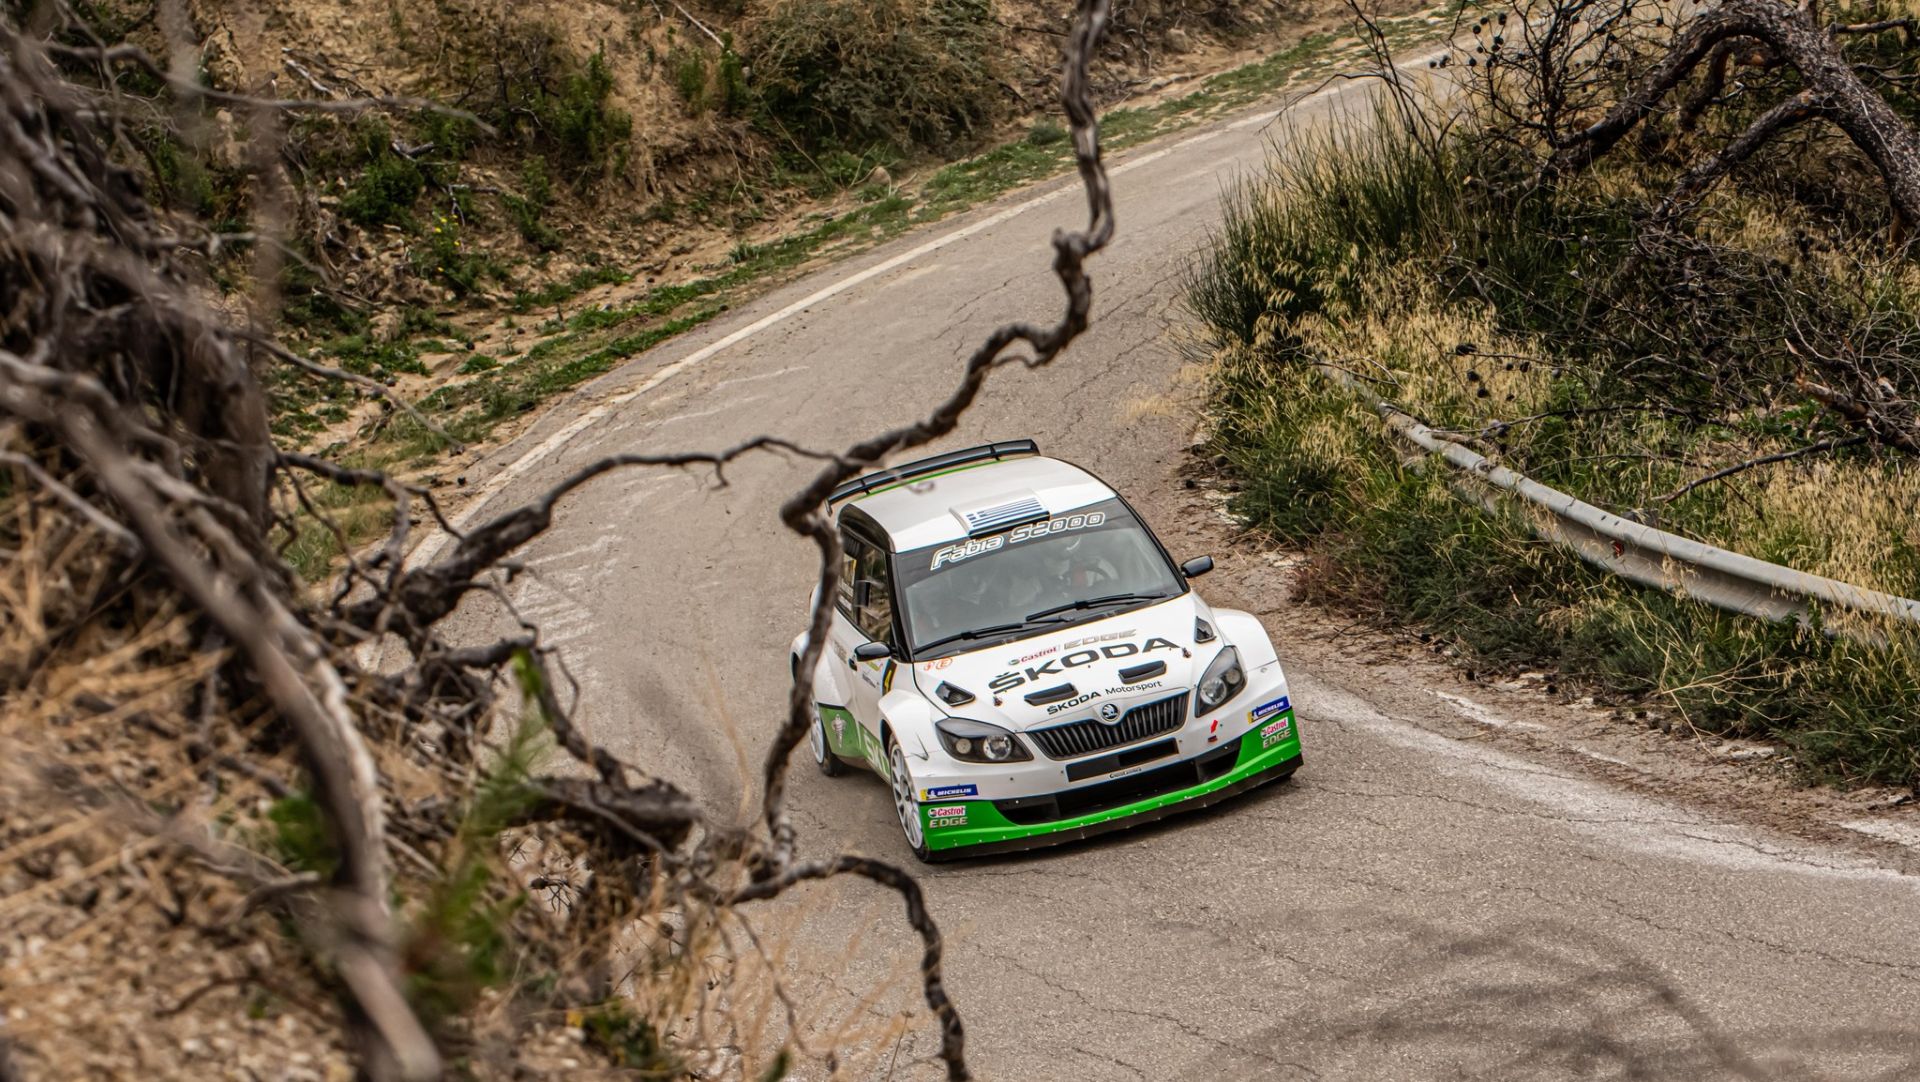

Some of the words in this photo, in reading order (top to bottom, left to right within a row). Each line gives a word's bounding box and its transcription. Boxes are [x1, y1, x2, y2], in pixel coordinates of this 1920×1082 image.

[930, 535, 1005, 571] Fabia
[1009, 512, 1106, 543] S2000
[1020, 646, 1057, 663] Castrol
[1062, 629, 1137, 650] EDGE
[988, 637, 1181, 695] ŠKODA
[1046, 691, 1102, 715] ŠKODA
[1104, 680, 1162, 695] Motorsport
[1257, 701, 1284, 716] MICHELIN
[1266, 719, 1287, 734] Castrol
[1263, 728, 1292, 749] EDGE
[937, 788, 972, 796] MICHELIN
[937, 807, 964, 816] Castrol
[929, 817, 968, 829] EDGE
